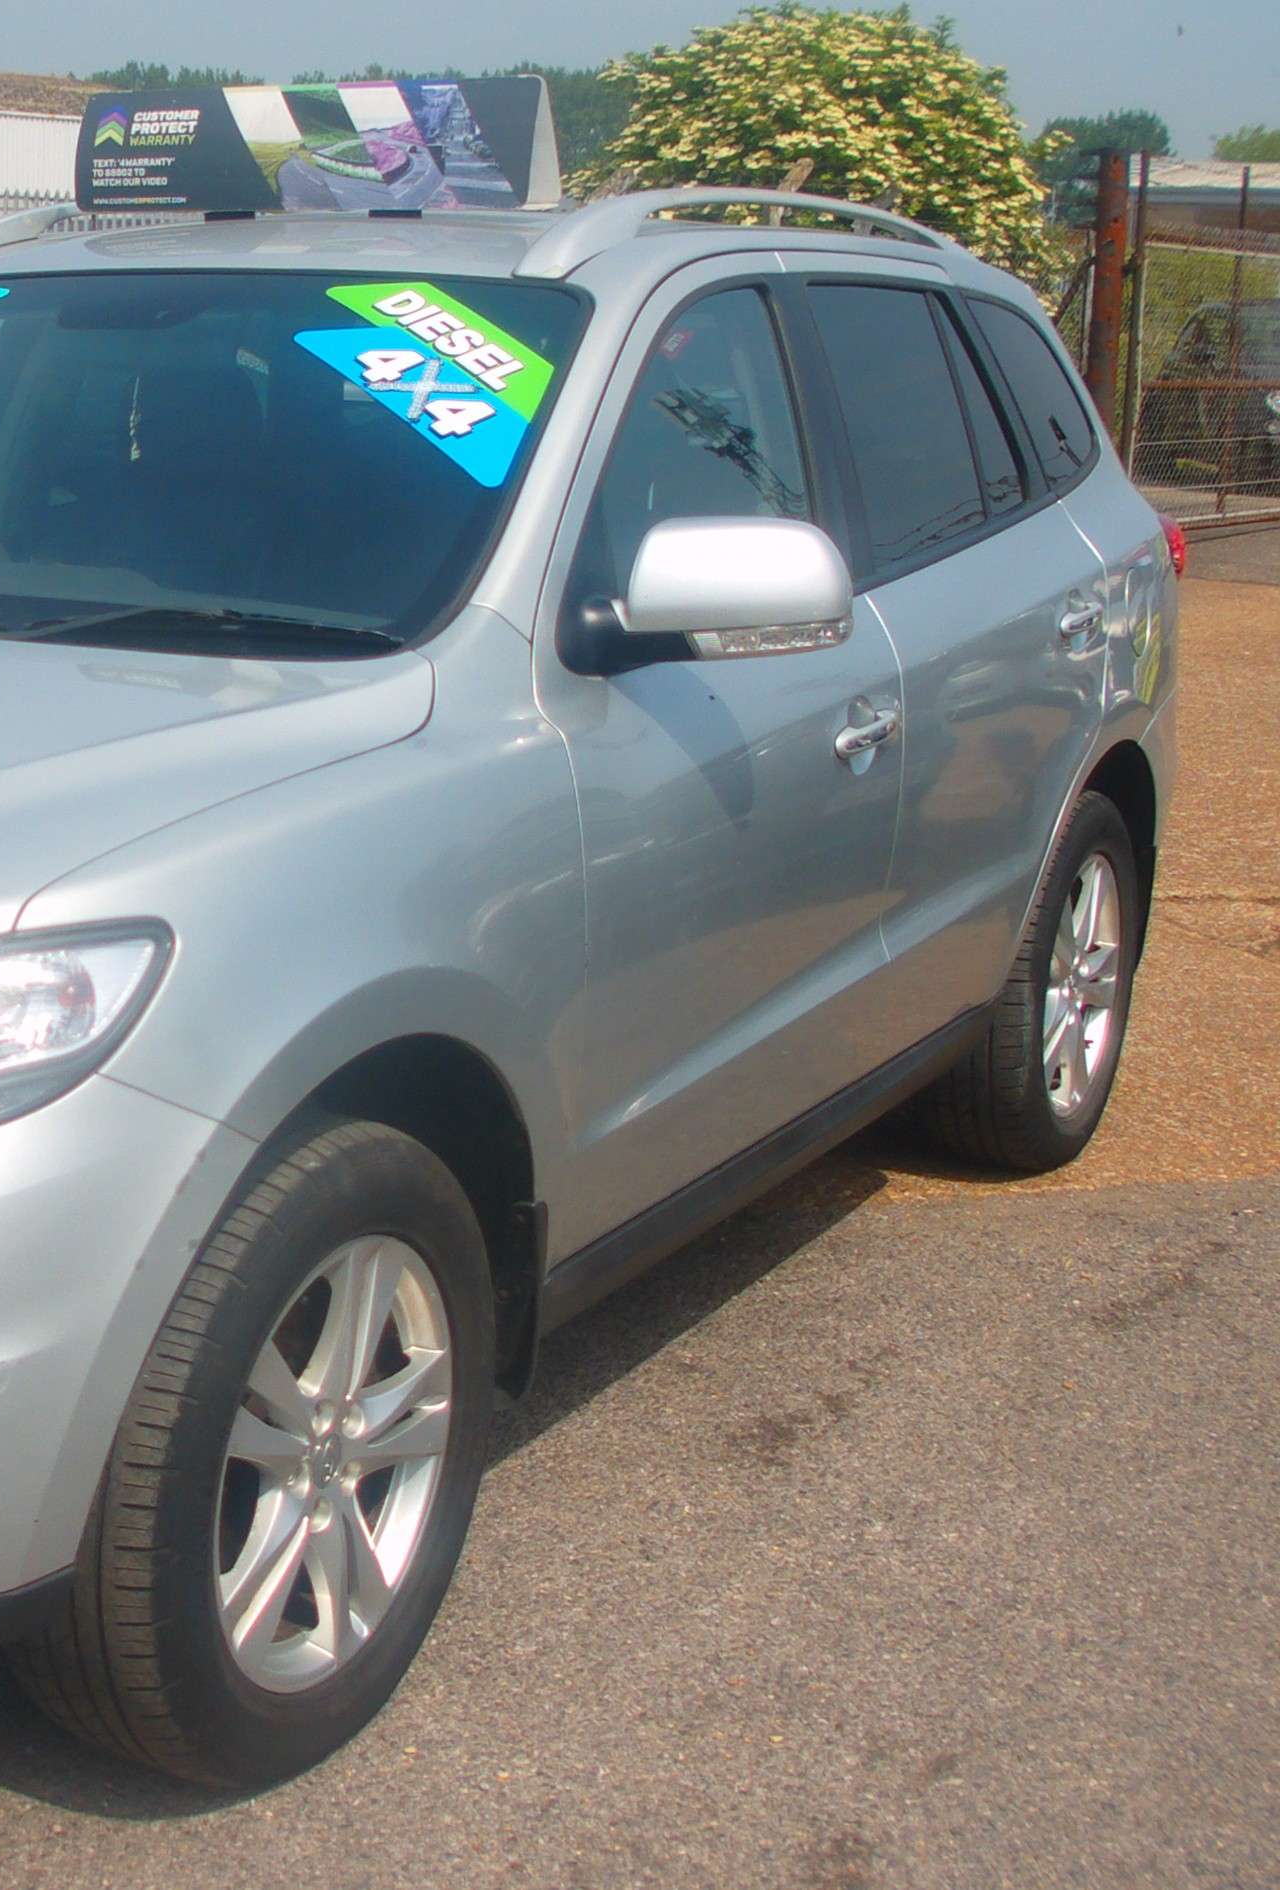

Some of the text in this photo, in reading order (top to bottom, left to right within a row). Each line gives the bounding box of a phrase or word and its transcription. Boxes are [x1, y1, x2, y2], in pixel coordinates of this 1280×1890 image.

[133, 109, 200, 121] CUSTOMER
[130, 121, 198, 135] PROTECT
[129, 134, 196, 146] WARRANTY
[92, 158, 117, 167] TEXT:
[92, 168, 104, 177] TO
[134, 168, 145, 177] TO
[92, 177, 168, 187] WATCH OUR VIDEO
[372, 288, 526, 392] DIESEL
